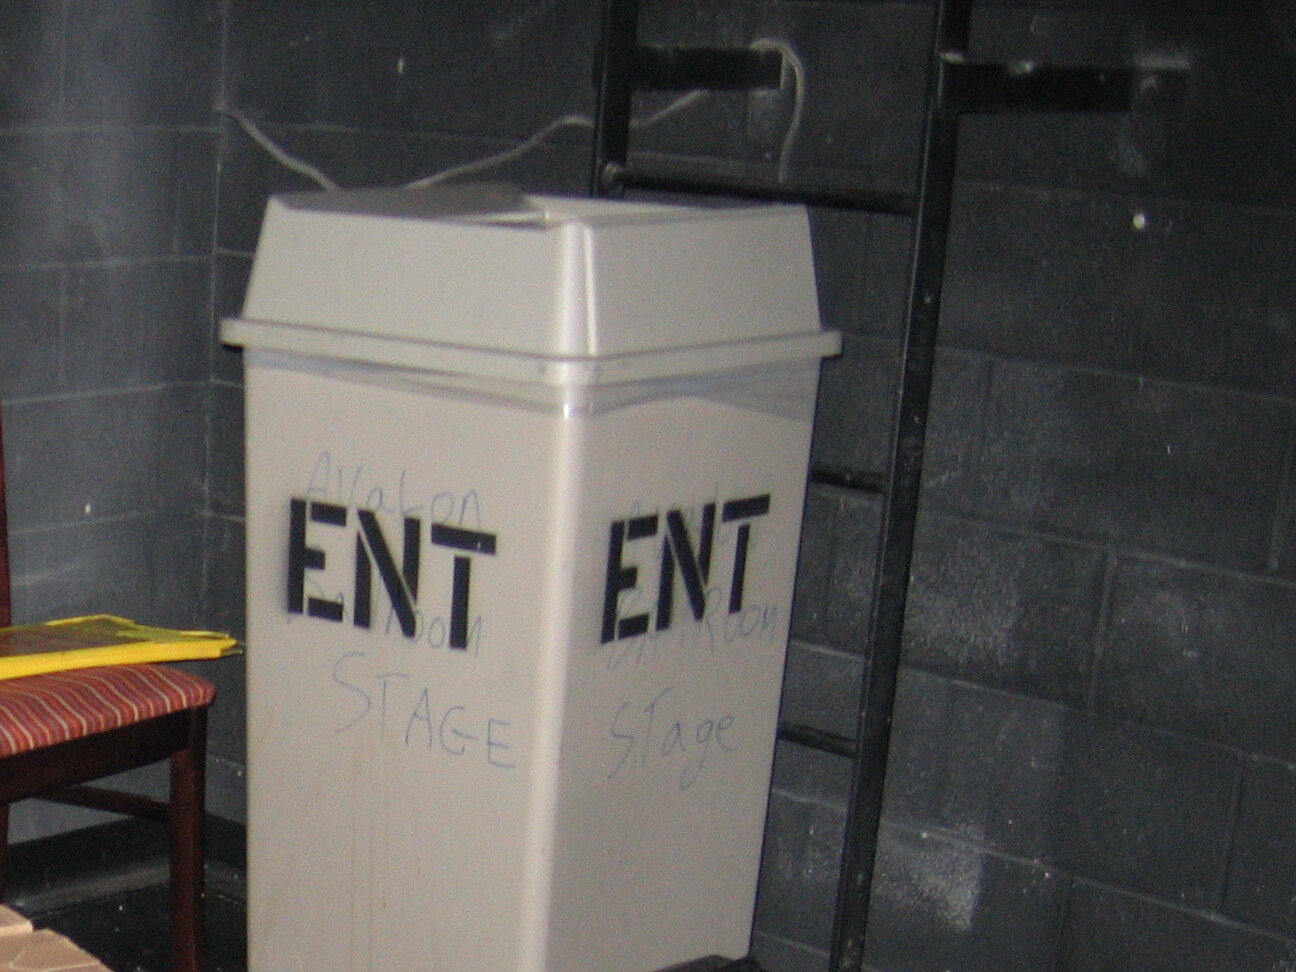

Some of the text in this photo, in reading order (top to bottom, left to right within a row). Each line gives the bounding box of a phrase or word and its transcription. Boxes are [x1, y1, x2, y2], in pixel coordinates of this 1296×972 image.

[287, 496, 497, 651] ENT
[602, 493, 771, 644] ENT
[333, 652, 516, 769] STAGE
